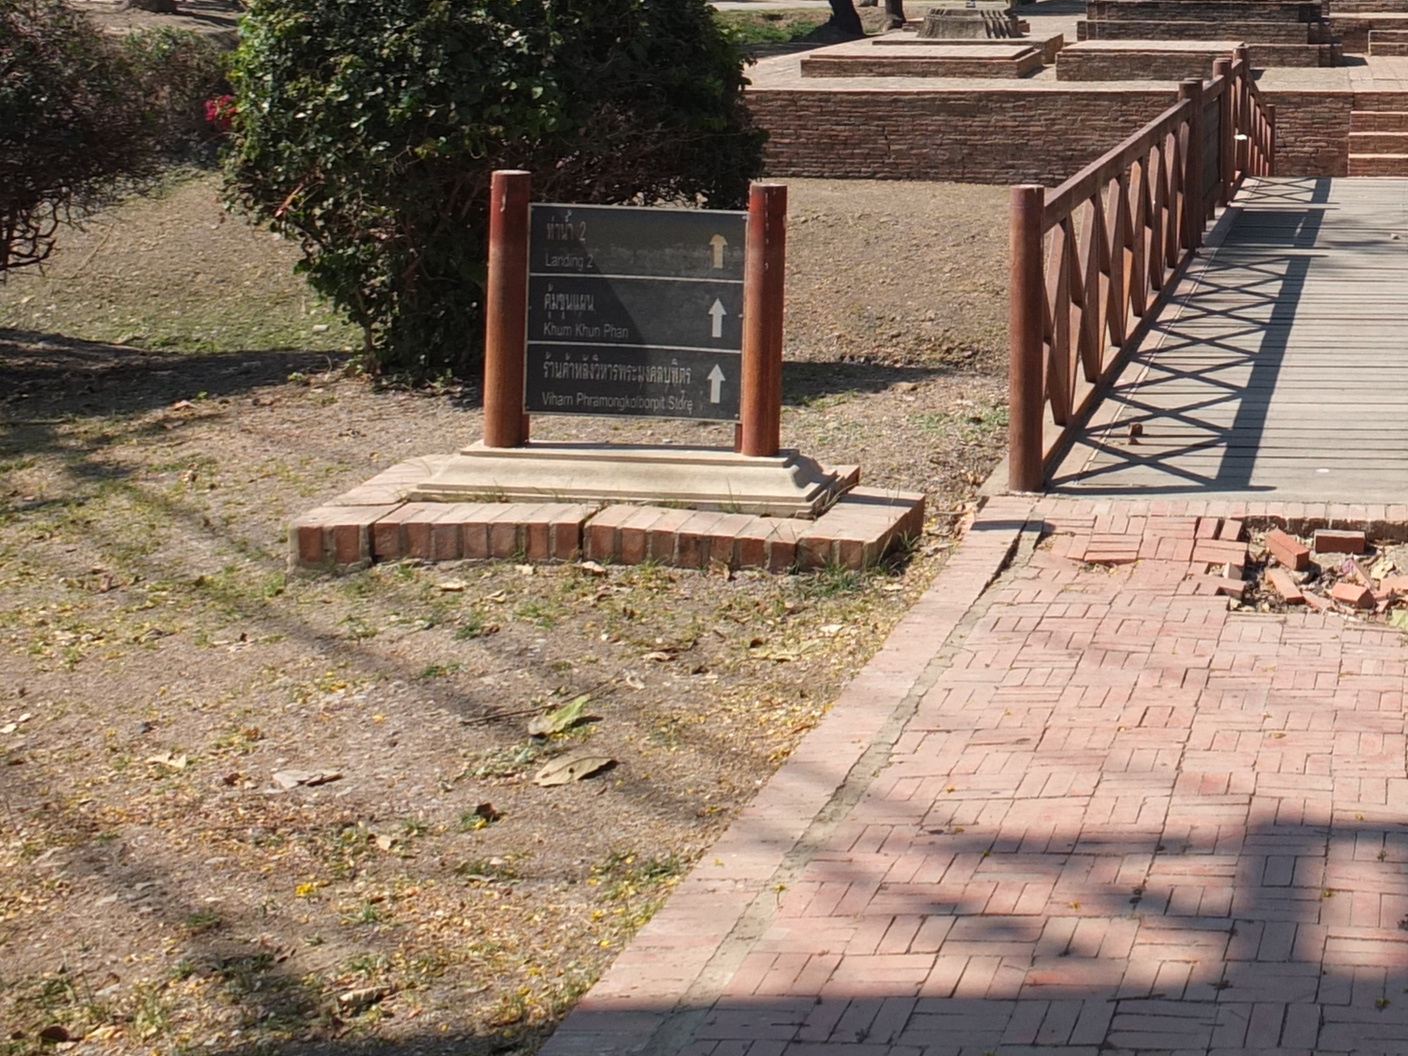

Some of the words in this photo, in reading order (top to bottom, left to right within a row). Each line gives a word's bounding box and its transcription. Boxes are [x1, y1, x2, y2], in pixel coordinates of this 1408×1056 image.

[579, 220, 587, 241] 2
[545, 252, 584, 271] Landing
[586, 253, 595, 268] 2
[543, 322, 572, 336] Khum
[575, 323, 601, 338] Khun
[603, 323, 629, 339] Phan
